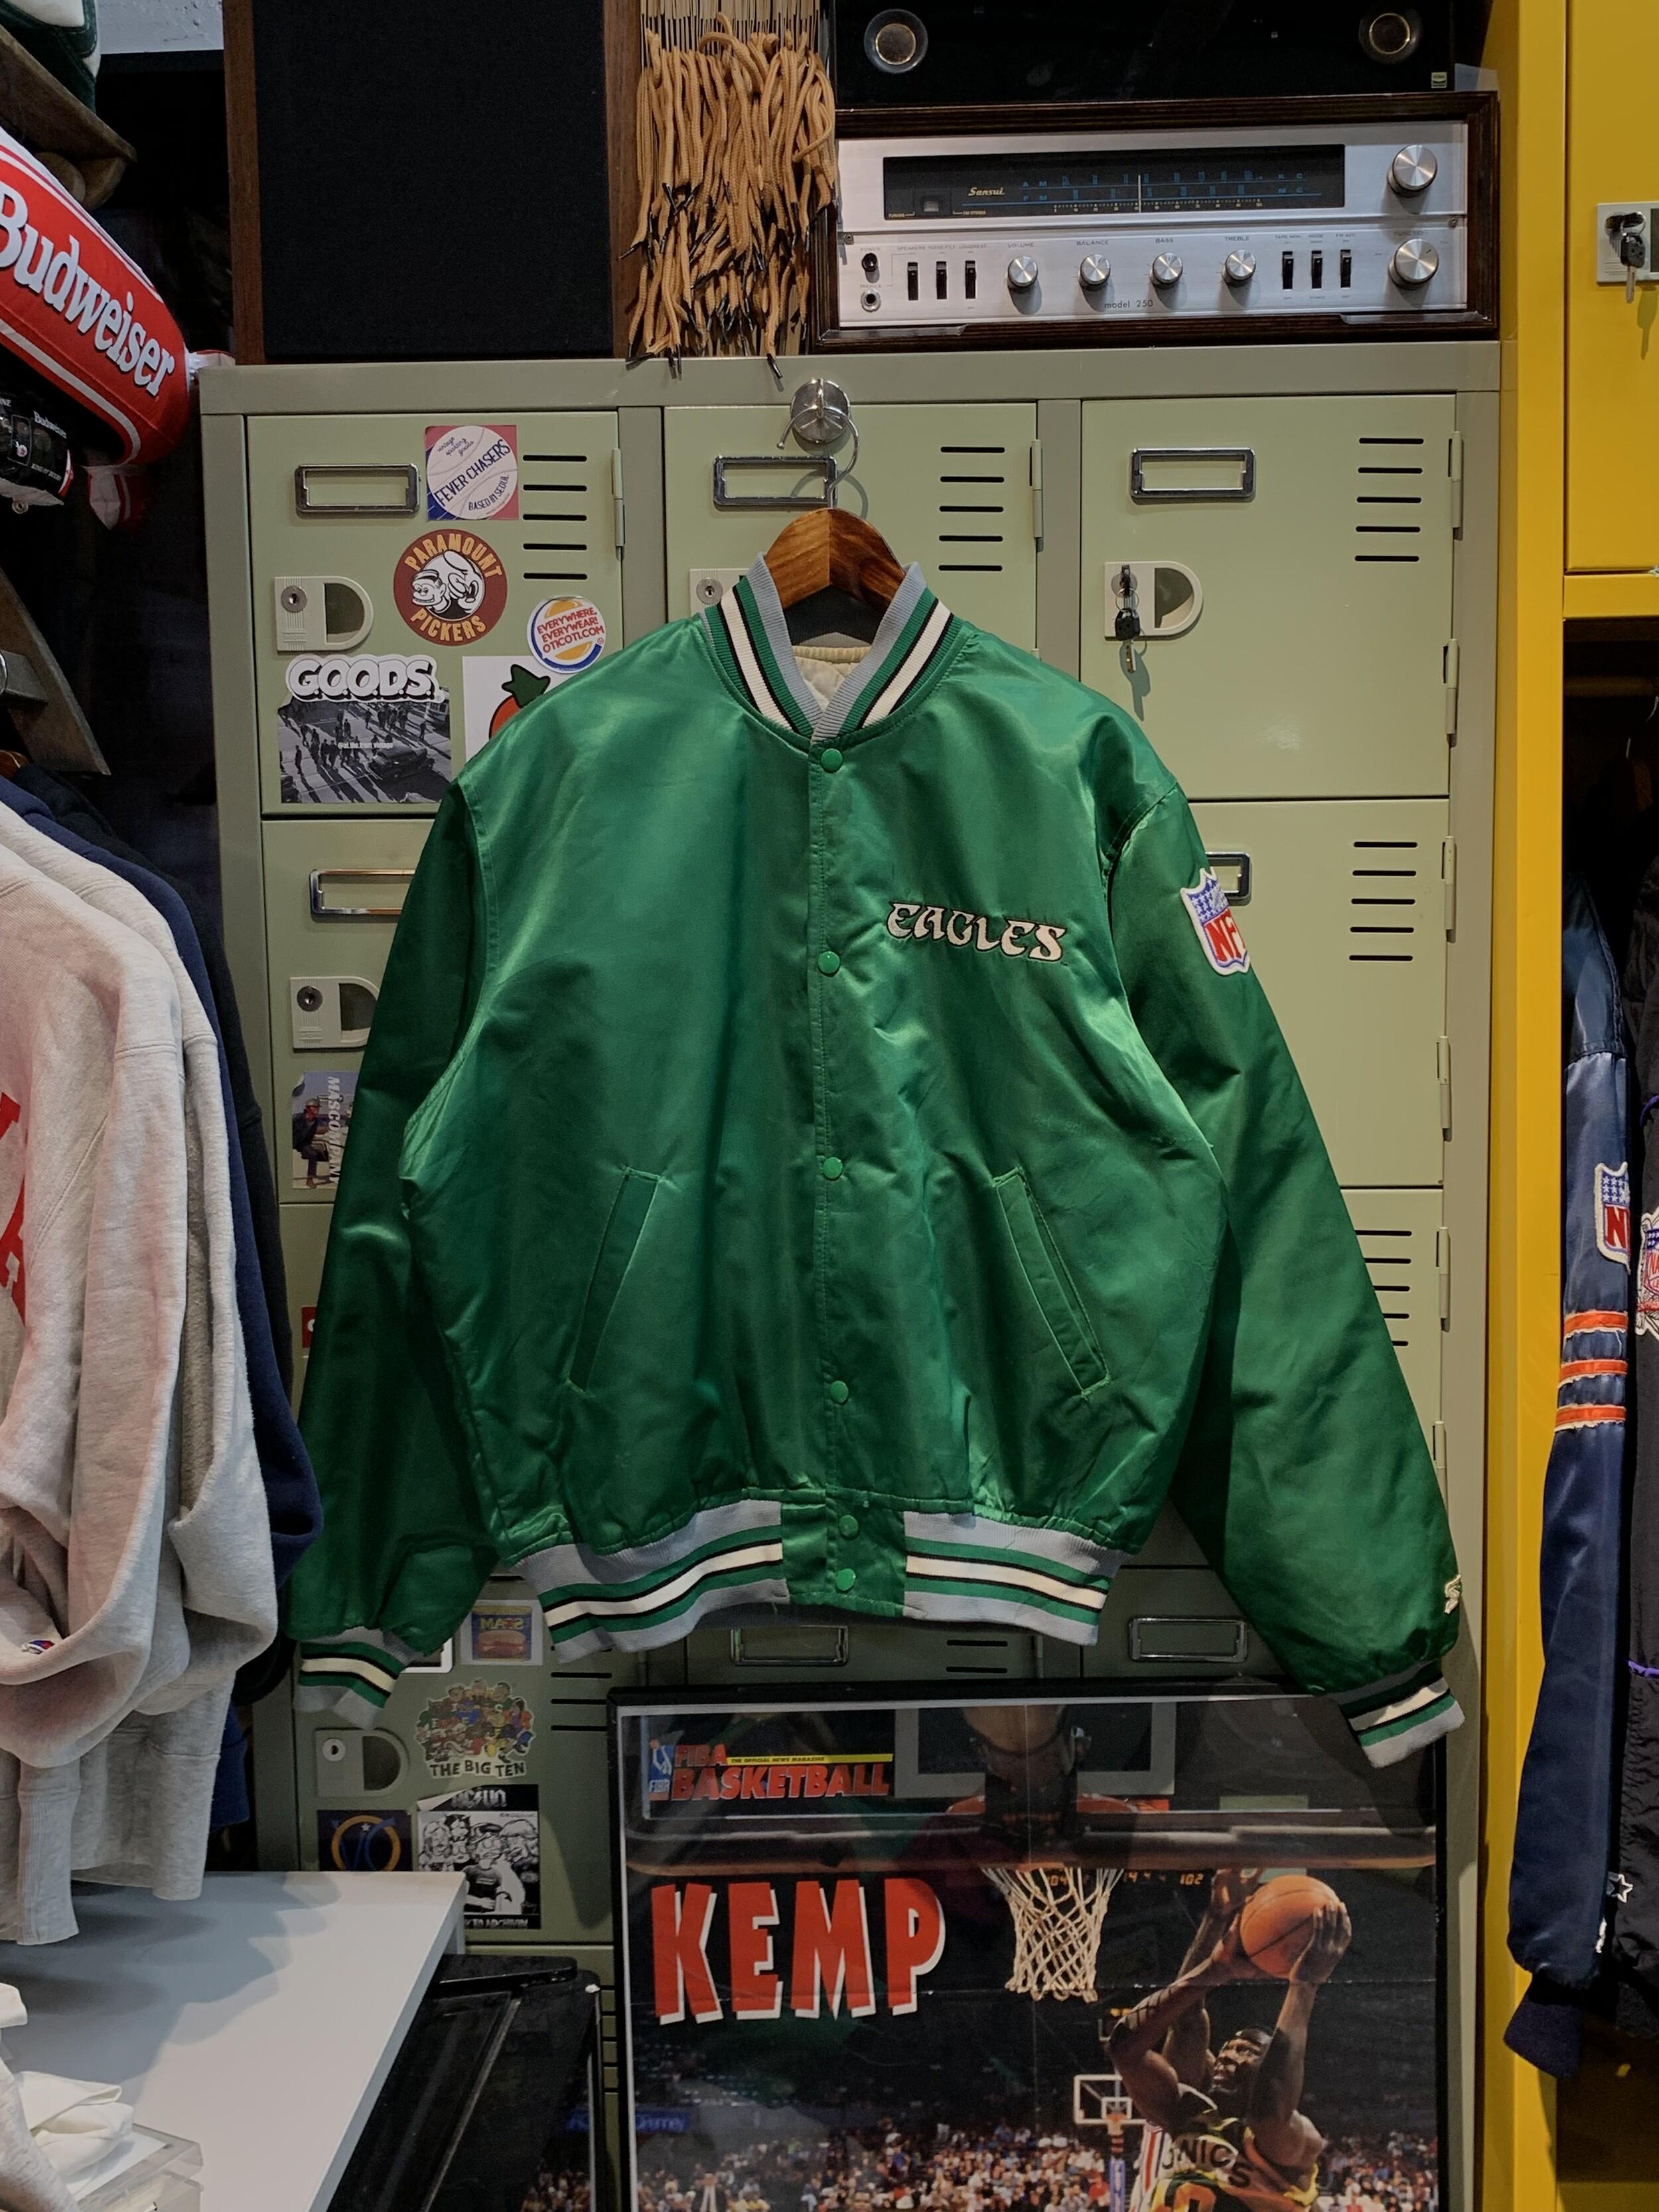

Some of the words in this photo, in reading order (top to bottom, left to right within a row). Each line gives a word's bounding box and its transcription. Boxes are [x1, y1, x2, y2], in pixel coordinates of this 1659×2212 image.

[968, 186, 1006, 197] Sansui
[0, 181, 175, 396] Budweiser
[1104, 301, 1131, 309] model
[1136, 299, 1154, 308] 250
[434, 474, 469, 507] FEVER
[466, 439, 511, 479] CHASERS
[469, 497, 491, 510] BASED
[489, 493, 498, 504] IN
[494, 475, 510, 497] SEOUL
[404, 533, 502, 578] PARAMOUNT
[410, 612, 486, 642] PICKERS
[541, 617, 599, 643] EVERYWEAR!
[886, 901, 1066, 962] EAGLES
[430, 1763, 461, 1777] THE
[465, 1760, 491, 1775] BIG
[494, 1762, 525, 1777] TEN
[674, 1743, 728, 1767] FIBA
[671, 1764, 890, 1801] BASKETBALL
[651, 1878, 946, 2026] KEMP
